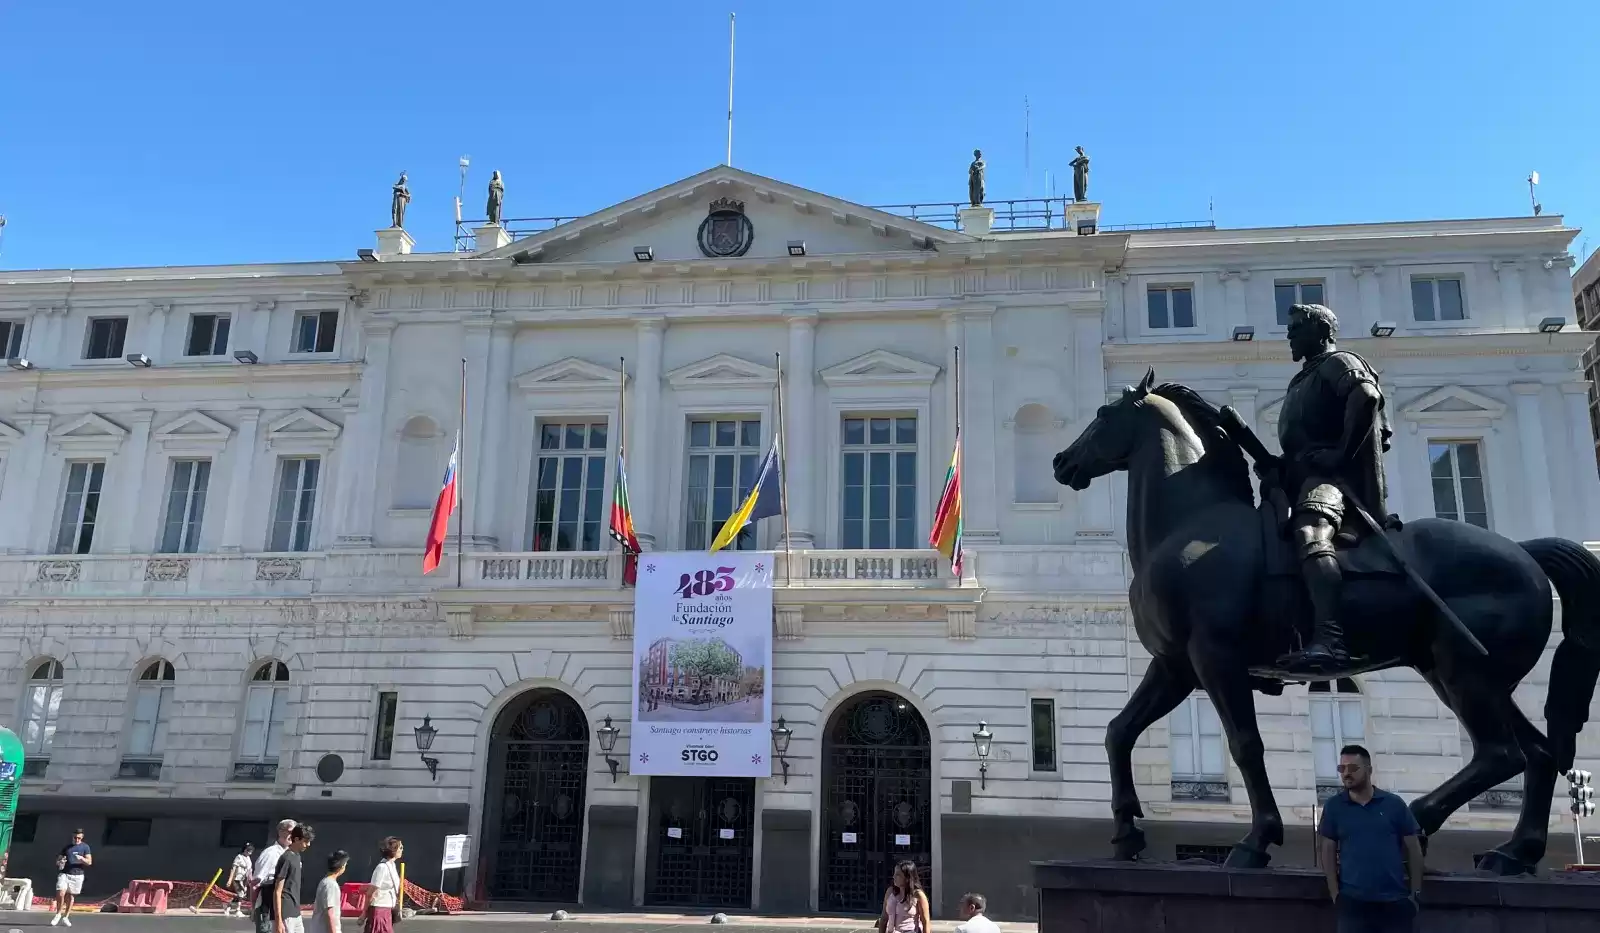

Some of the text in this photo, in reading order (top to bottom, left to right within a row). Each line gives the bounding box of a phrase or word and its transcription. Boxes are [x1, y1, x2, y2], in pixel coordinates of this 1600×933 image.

[673, 566, 736, 599] 485
[676, 603, 732, 613] Fundación
[671, 614, 734, 628] de Santiago
[650, 725, 753, 736] Santiago construye historias
[681, 749, 719, 762] STGO
